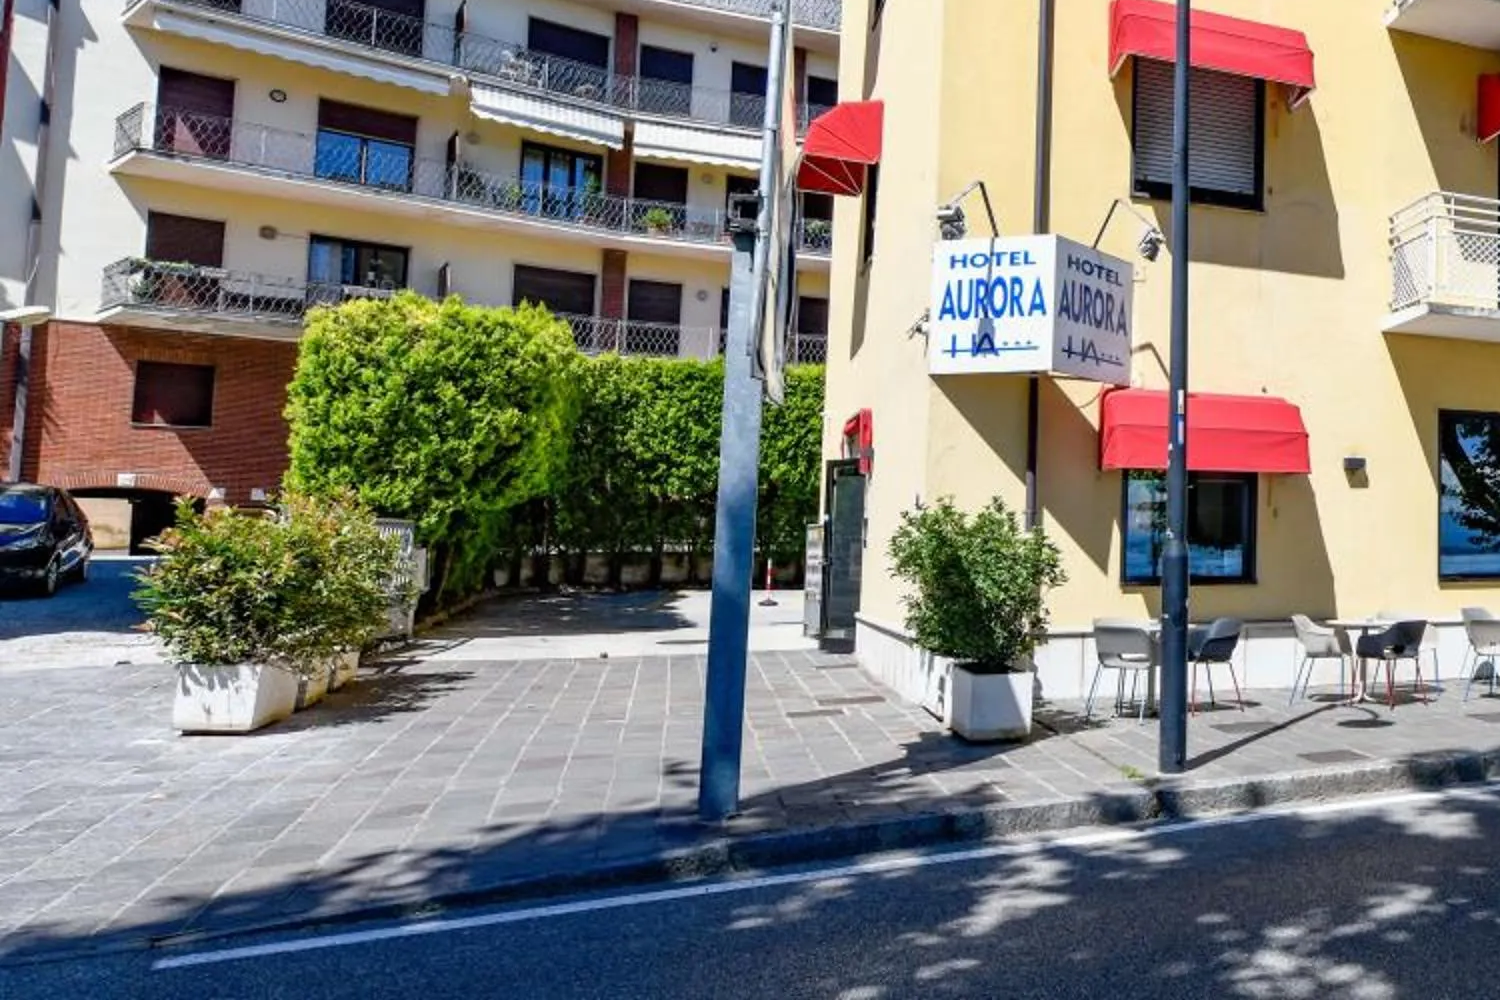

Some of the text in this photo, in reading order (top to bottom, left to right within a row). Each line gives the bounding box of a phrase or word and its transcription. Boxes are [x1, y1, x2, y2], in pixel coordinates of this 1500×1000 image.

[950, 250, 1036, 269] HOTEL
[1067, 253, 1124, 287] HOTEL
[939, 276, 1046, 320] AURORA
[1058, 279, 1129, 338] AURORA
